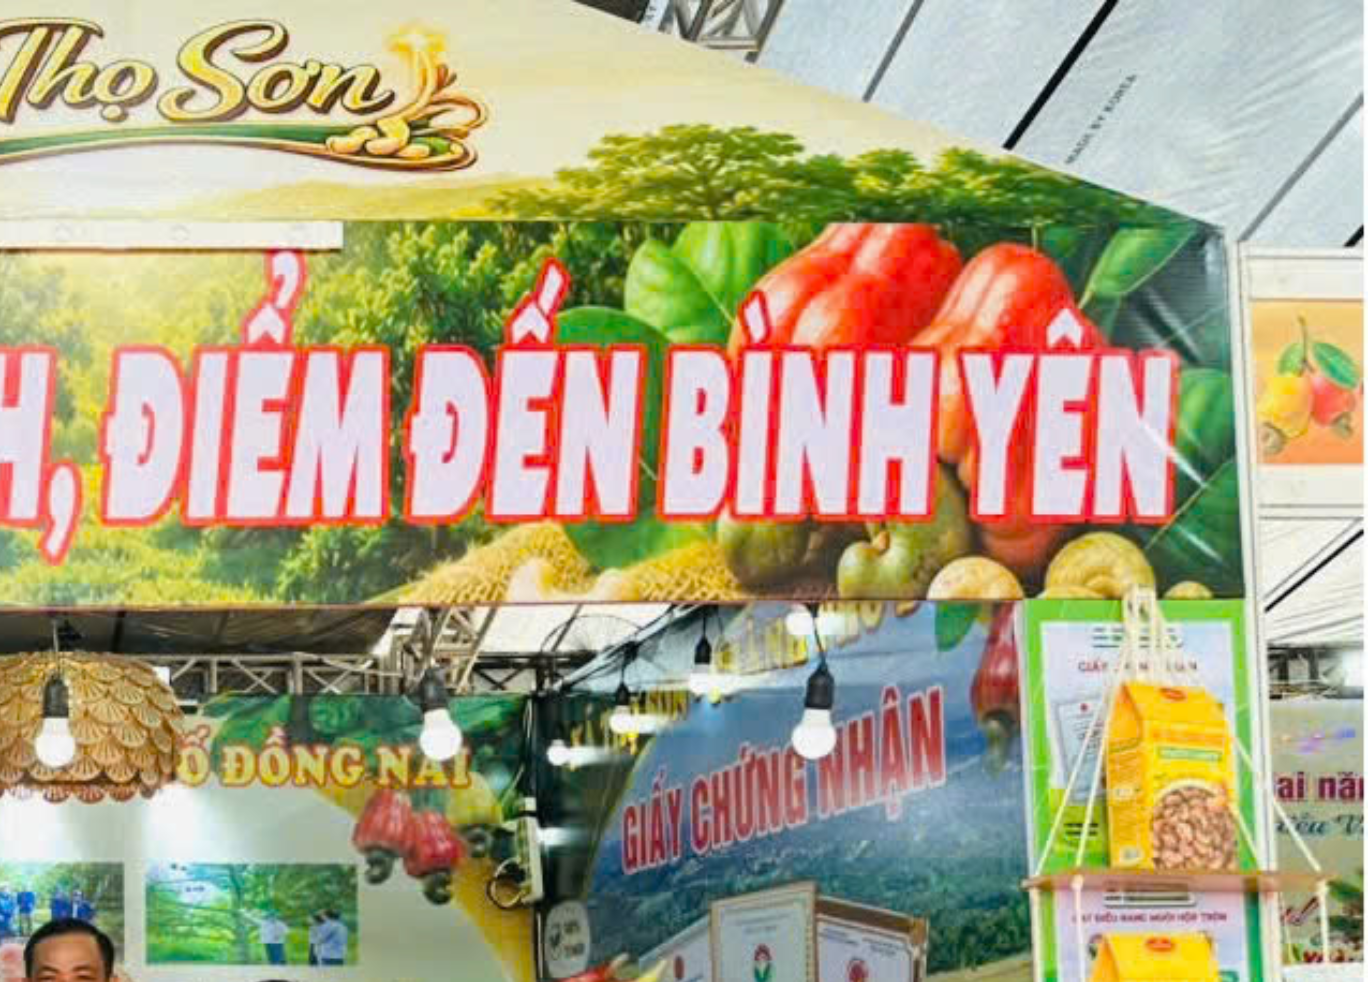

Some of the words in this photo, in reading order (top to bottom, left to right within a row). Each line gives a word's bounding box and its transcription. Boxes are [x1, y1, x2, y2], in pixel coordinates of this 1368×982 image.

[158, 19, 392, 123] Sơn
[100, 247, 388, 526] ĐIỂM
[405, 258, 646, 524] ĐẾN
[657, 291, 940, 524] BÌNH
[958, 302, 1180, 526] YÊN
[220, 725, 366, 788] ĐỒNG
[376, 743, 472, 789] NAI
[622, 766, 682, 875] GIẤY
[690, 741, 807, 858] CHỨNG
[818, 686, 946, 822] NHẬN
